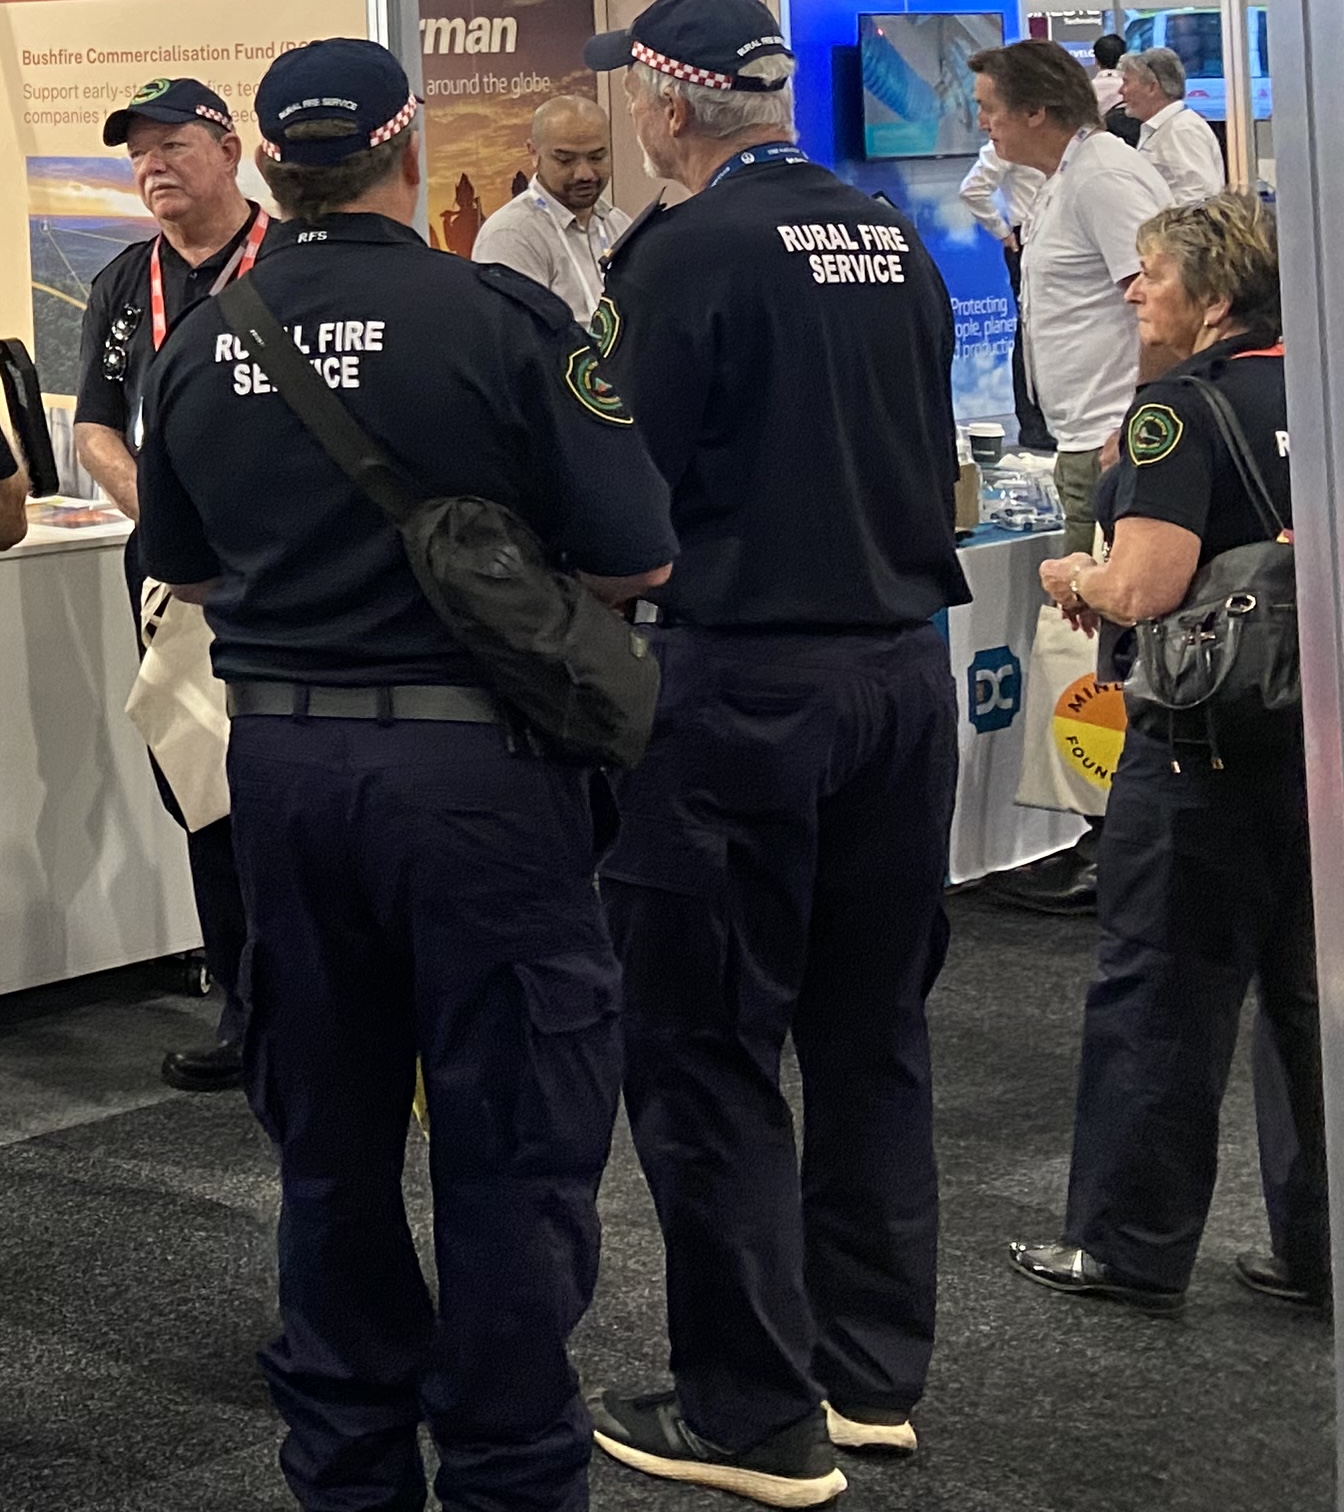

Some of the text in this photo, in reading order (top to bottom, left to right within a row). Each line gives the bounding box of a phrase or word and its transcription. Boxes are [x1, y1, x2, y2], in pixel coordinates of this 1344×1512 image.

[419, 17, 518, 55] rman
[22, 51, 82, 65] Bushfire
[86, 45, 230, 64] Commercialisation
[235, 43, 274, 59] Fund
[736, 39, 762, 57] RURAL
[23, 84, 78, 101] Support
[427, 71, 551, 99] around the globe
[321, 97, 359, 111] SERVICE
[24, 109, 98, 126] companies
[297, 230, 328, 244] RFS
[777, 224, 910, 253] RURAL FIRE
[809, 255, 905, 284] SERVICE
[951, 296, 1008, 317] Protecting
[318, 320, 386, 354] FIRE
